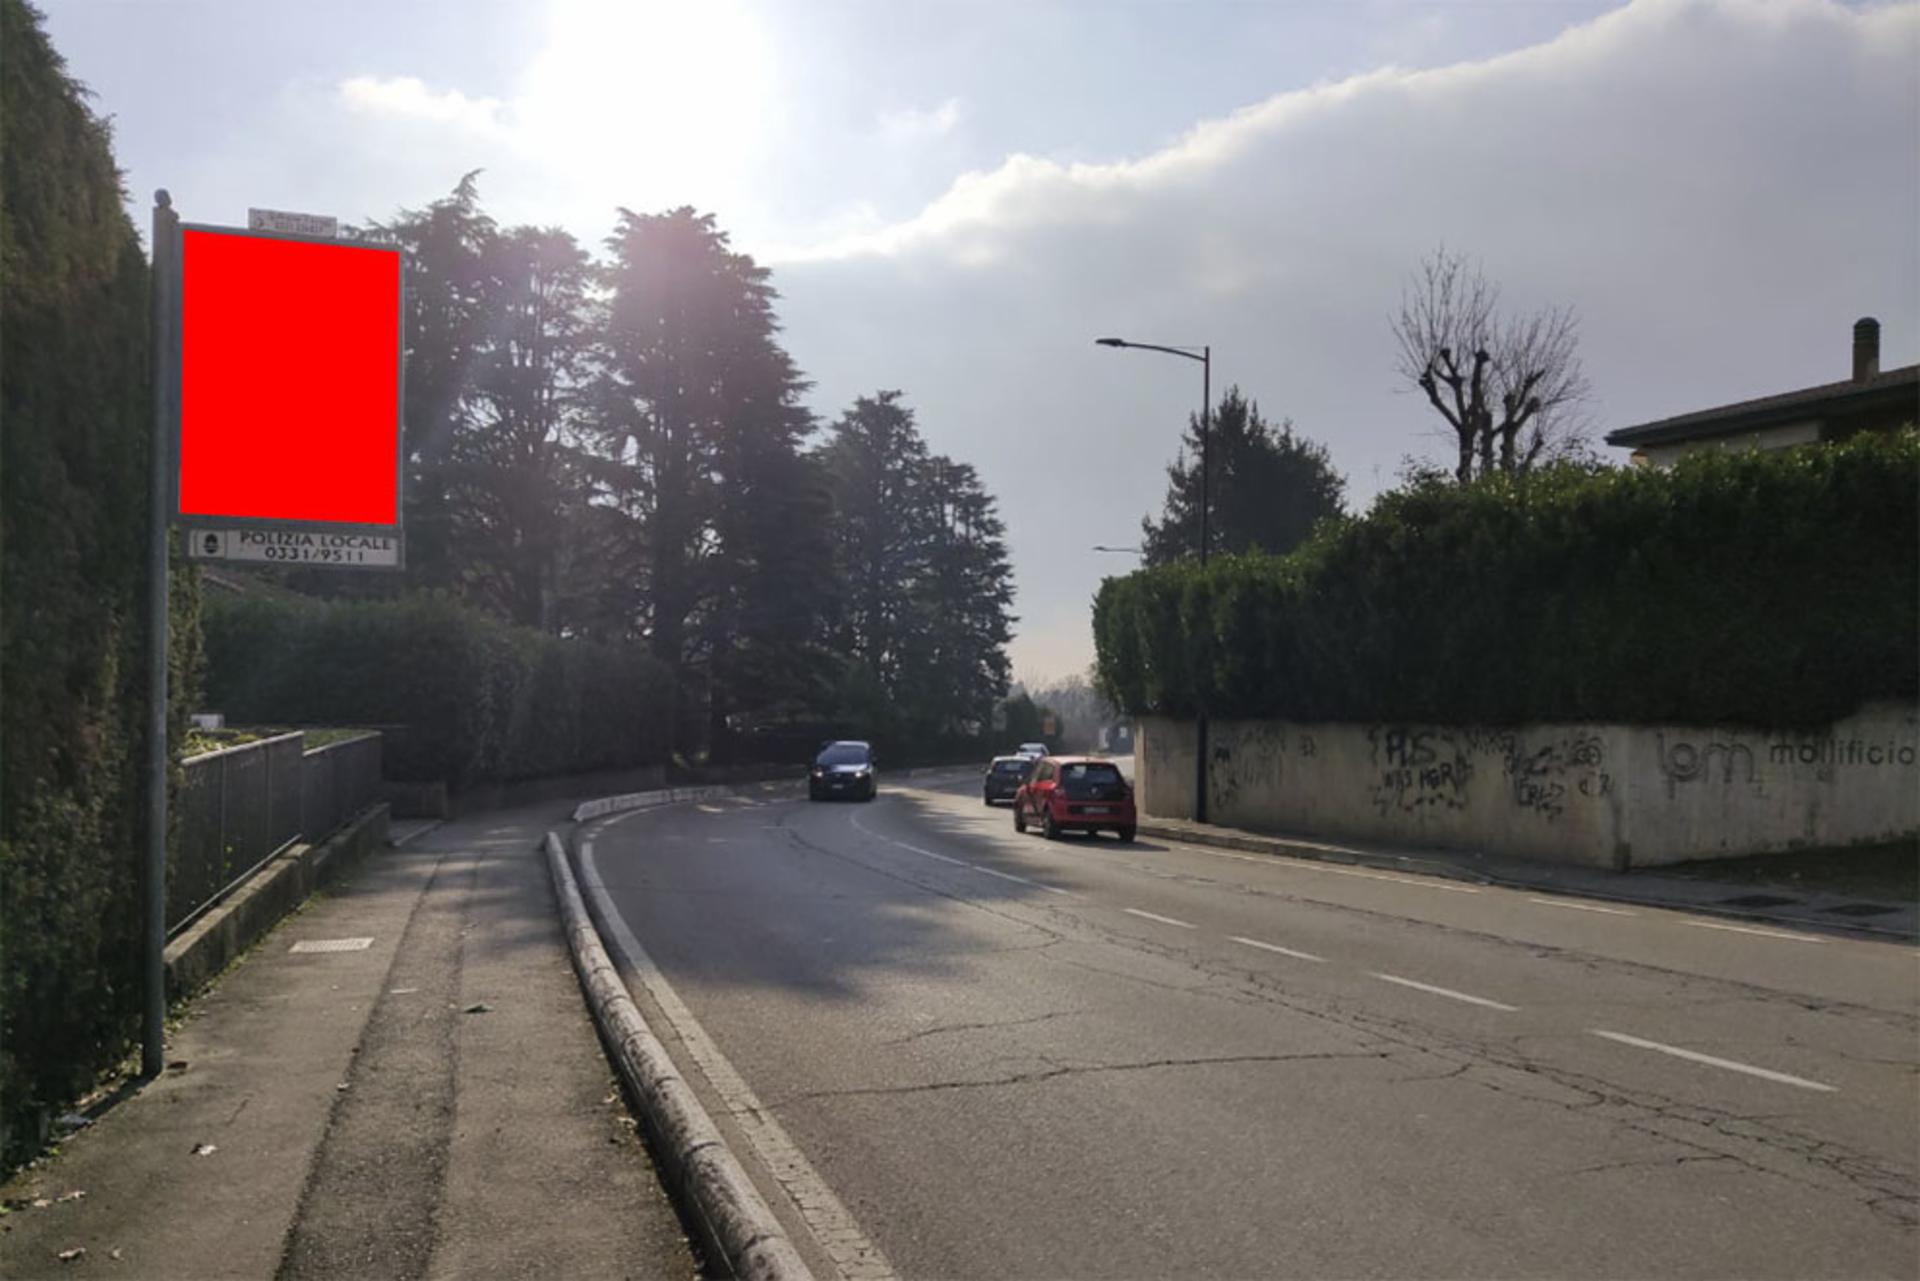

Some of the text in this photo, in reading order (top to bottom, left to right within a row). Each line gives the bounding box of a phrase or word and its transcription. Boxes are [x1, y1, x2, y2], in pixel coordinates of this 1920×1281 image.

[240, 531, 392, 550] POLIZIA LOCALE
[265, 547, 364, 562] 0331/9511
[1769, 738, 1916, 765] mollificio
